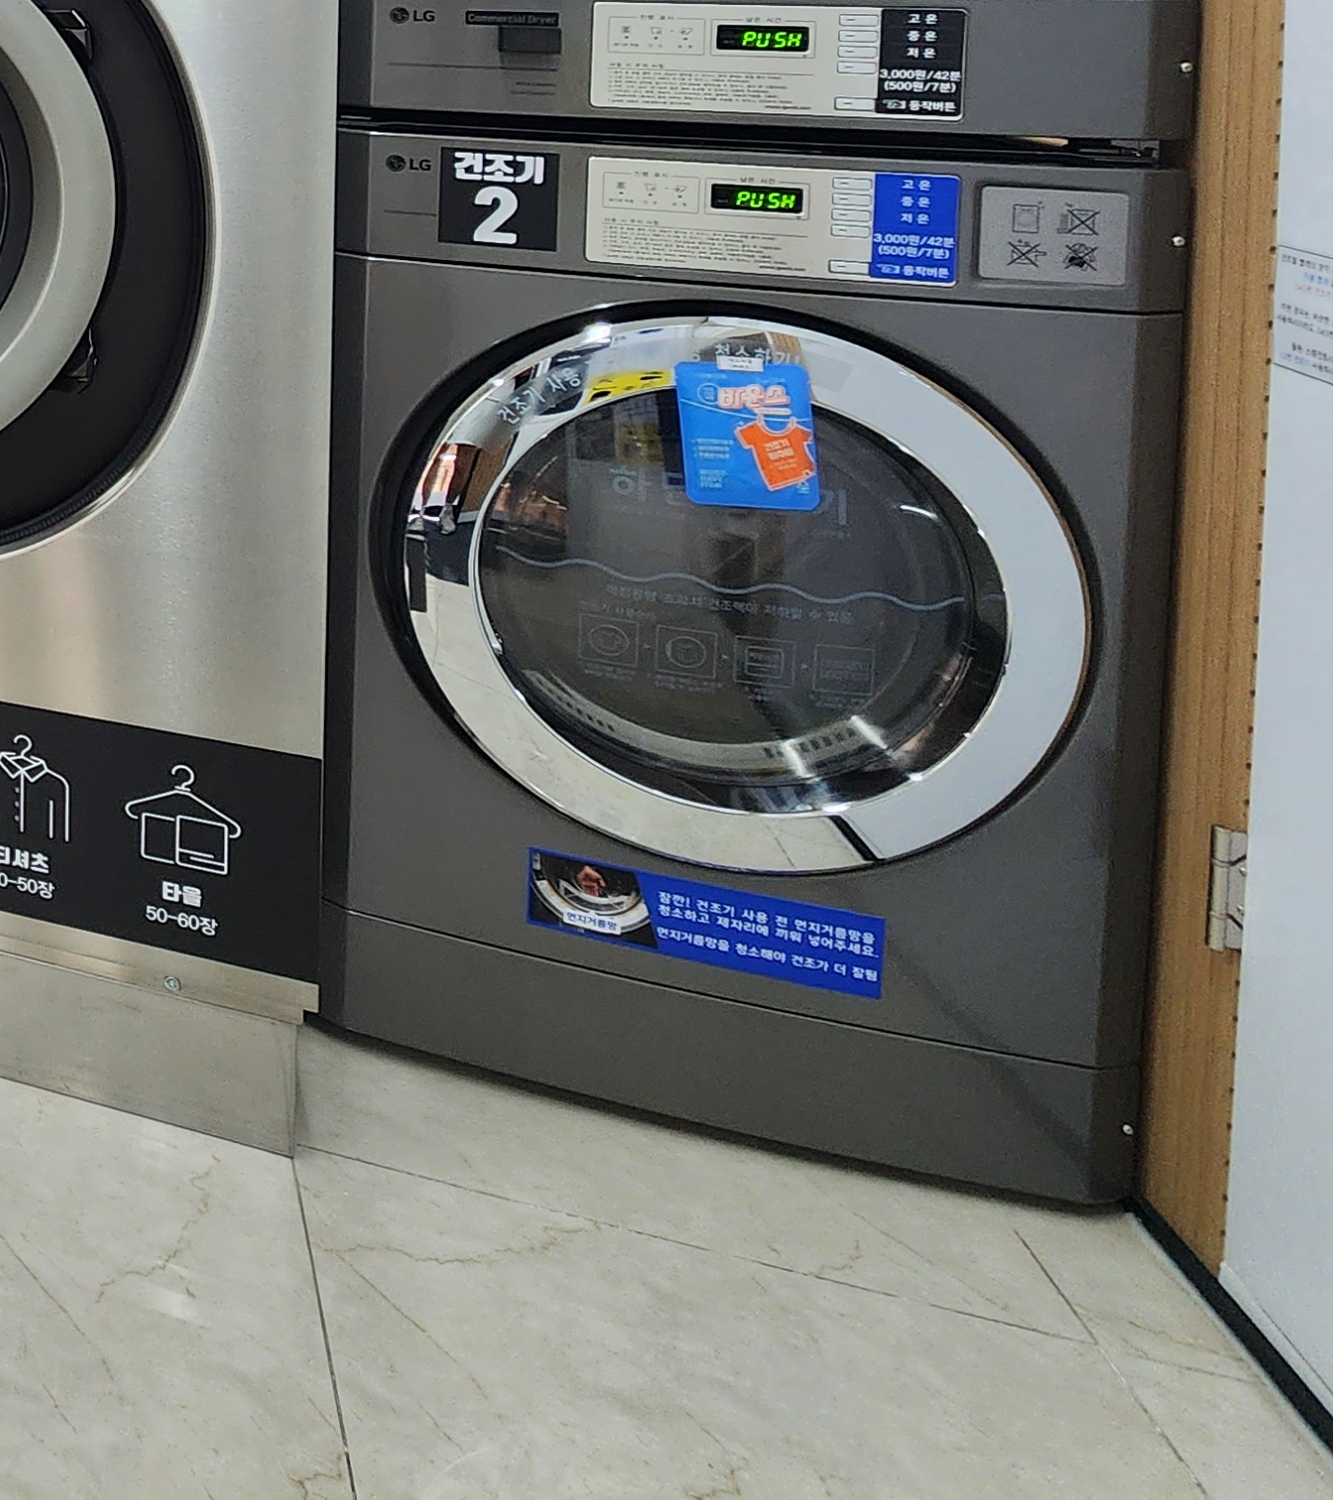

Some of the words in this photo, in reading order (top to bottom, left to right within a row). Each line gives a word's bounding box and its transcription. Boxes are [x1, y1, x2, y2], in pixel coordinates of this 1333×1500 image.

[413, 10, 435, 22] LG
[468, 13, 525, 24] Commercial
[742, 31, 802, 48] PUSH
[879, 69, 961, 81] 3,000원/42분
[884, 81, 957, 93] (500원/7분)
[909, 100, 956, 112] 동작버튼
[409, 158, 431, 171] LG
[454, 151, 545, 185] 건조기
[736, 191, 796, 209] PUSH
[473, 185, 518, 244] 2
[873, 233, 956, 248] 3,000원/42분
[878, 245, 950, 259] (500원/7분)
[902, 265, 950, 279] 동작버튼
[497, 386, 546, 425] 건조기
[546, 367, 581, 392] 사용
[162, 881, 203, 908] 타올
[145, 906, 219, 936] 50-60장
[565, 912, 619, 931] 먼지거름망
[658, 891, 691, 908] 잠깐!
[696, 899, 736, 916] 건조기
[742, 907, 769, 923] 사용
[775, 914, 788, 927] 전
[795, 918, 876, 945] 먼지거름망을
[658, 904, 711, 925] 청소하고
[715, 916, 769, 937] 제자리에
[775, 927, 804, 943] 끼워
[808, 933, 880, 959] 넣어주세요.
[656, 926, 730, 952] 먼지거름망을
[735, 942, 787, 964] 청소해야
[791, 955, 830, 973] 건조가
[833, 962, 847, 976] 더
[851, 966, 879, 983] 잘됨
